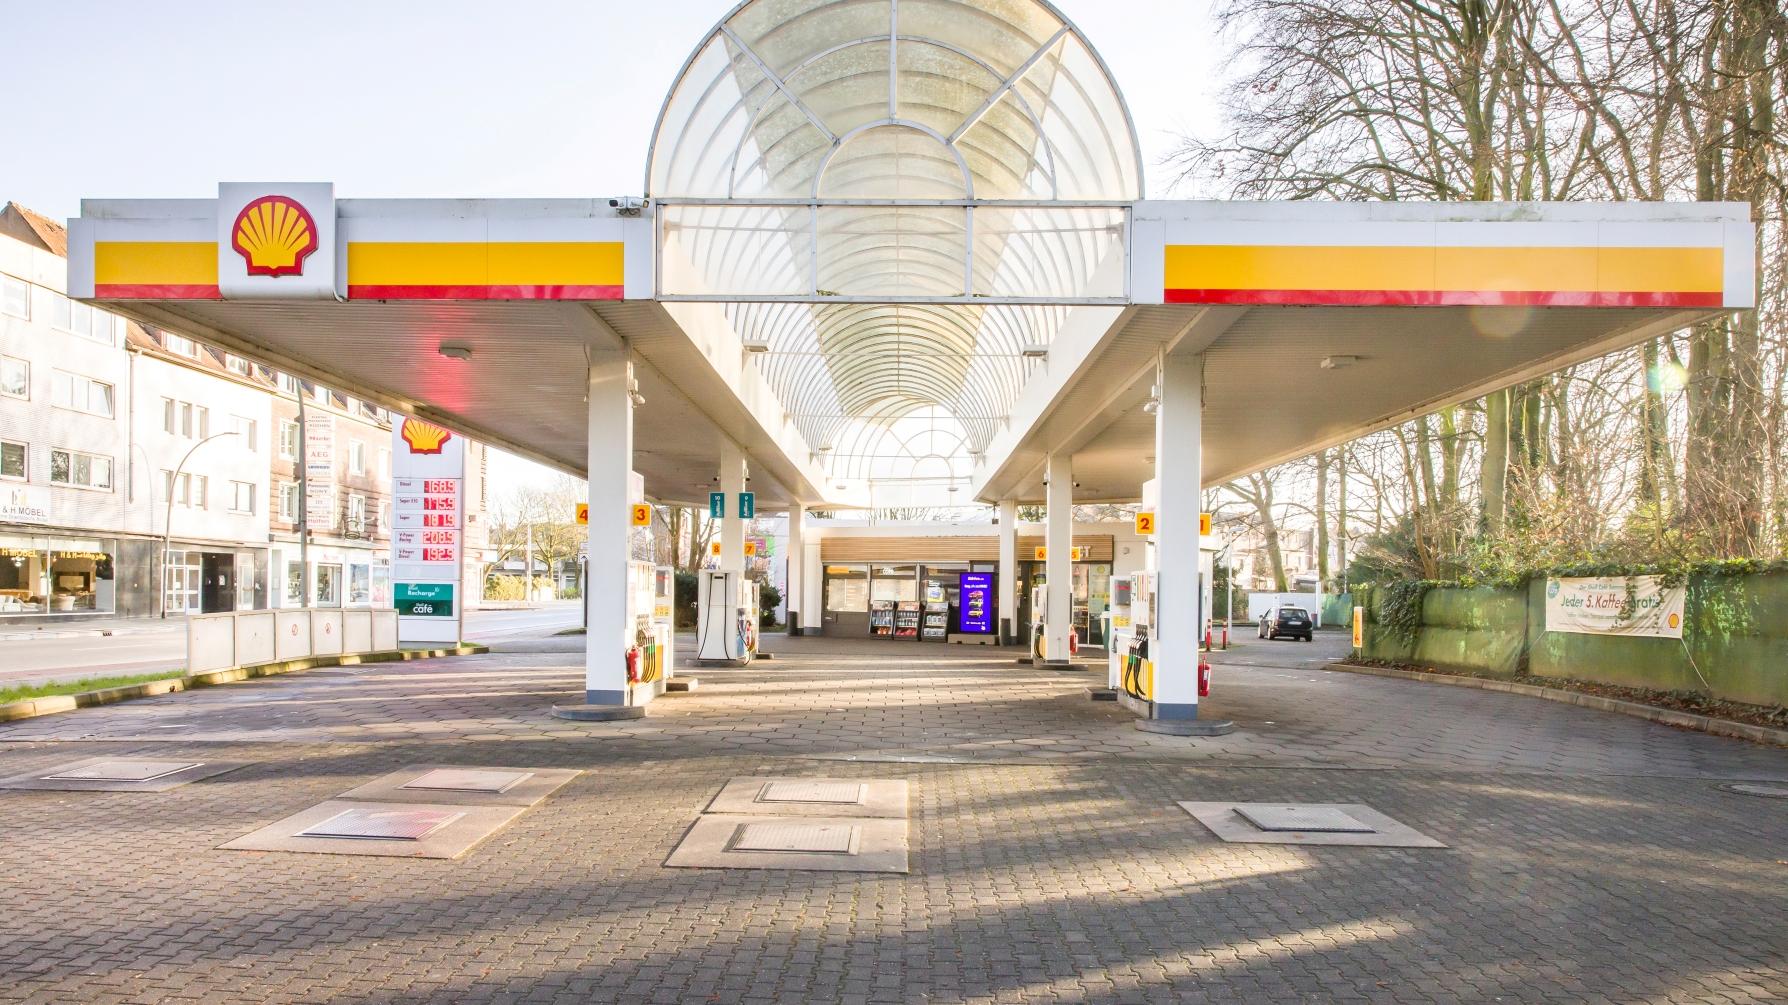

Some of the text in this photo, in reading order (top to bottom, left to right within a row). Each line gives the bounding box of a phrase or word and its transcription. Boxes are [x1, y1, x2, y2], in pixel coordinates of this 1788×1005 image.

[579, 509, 589, 520] 4
[637, 509, 645, 520] 3
[1140, 518, 1149, 529] 2
[1200, 520, 1204, 531] 1
[2, 548, 8, 556] H
[714, 545, 719, 553] 8
[1561, 593, 1584, 608] Jeder
[1586, 595, 1594, 608] 5.
[1596, 593, 1626, 609] Kaffee
[413, 604, 433, 614] café
